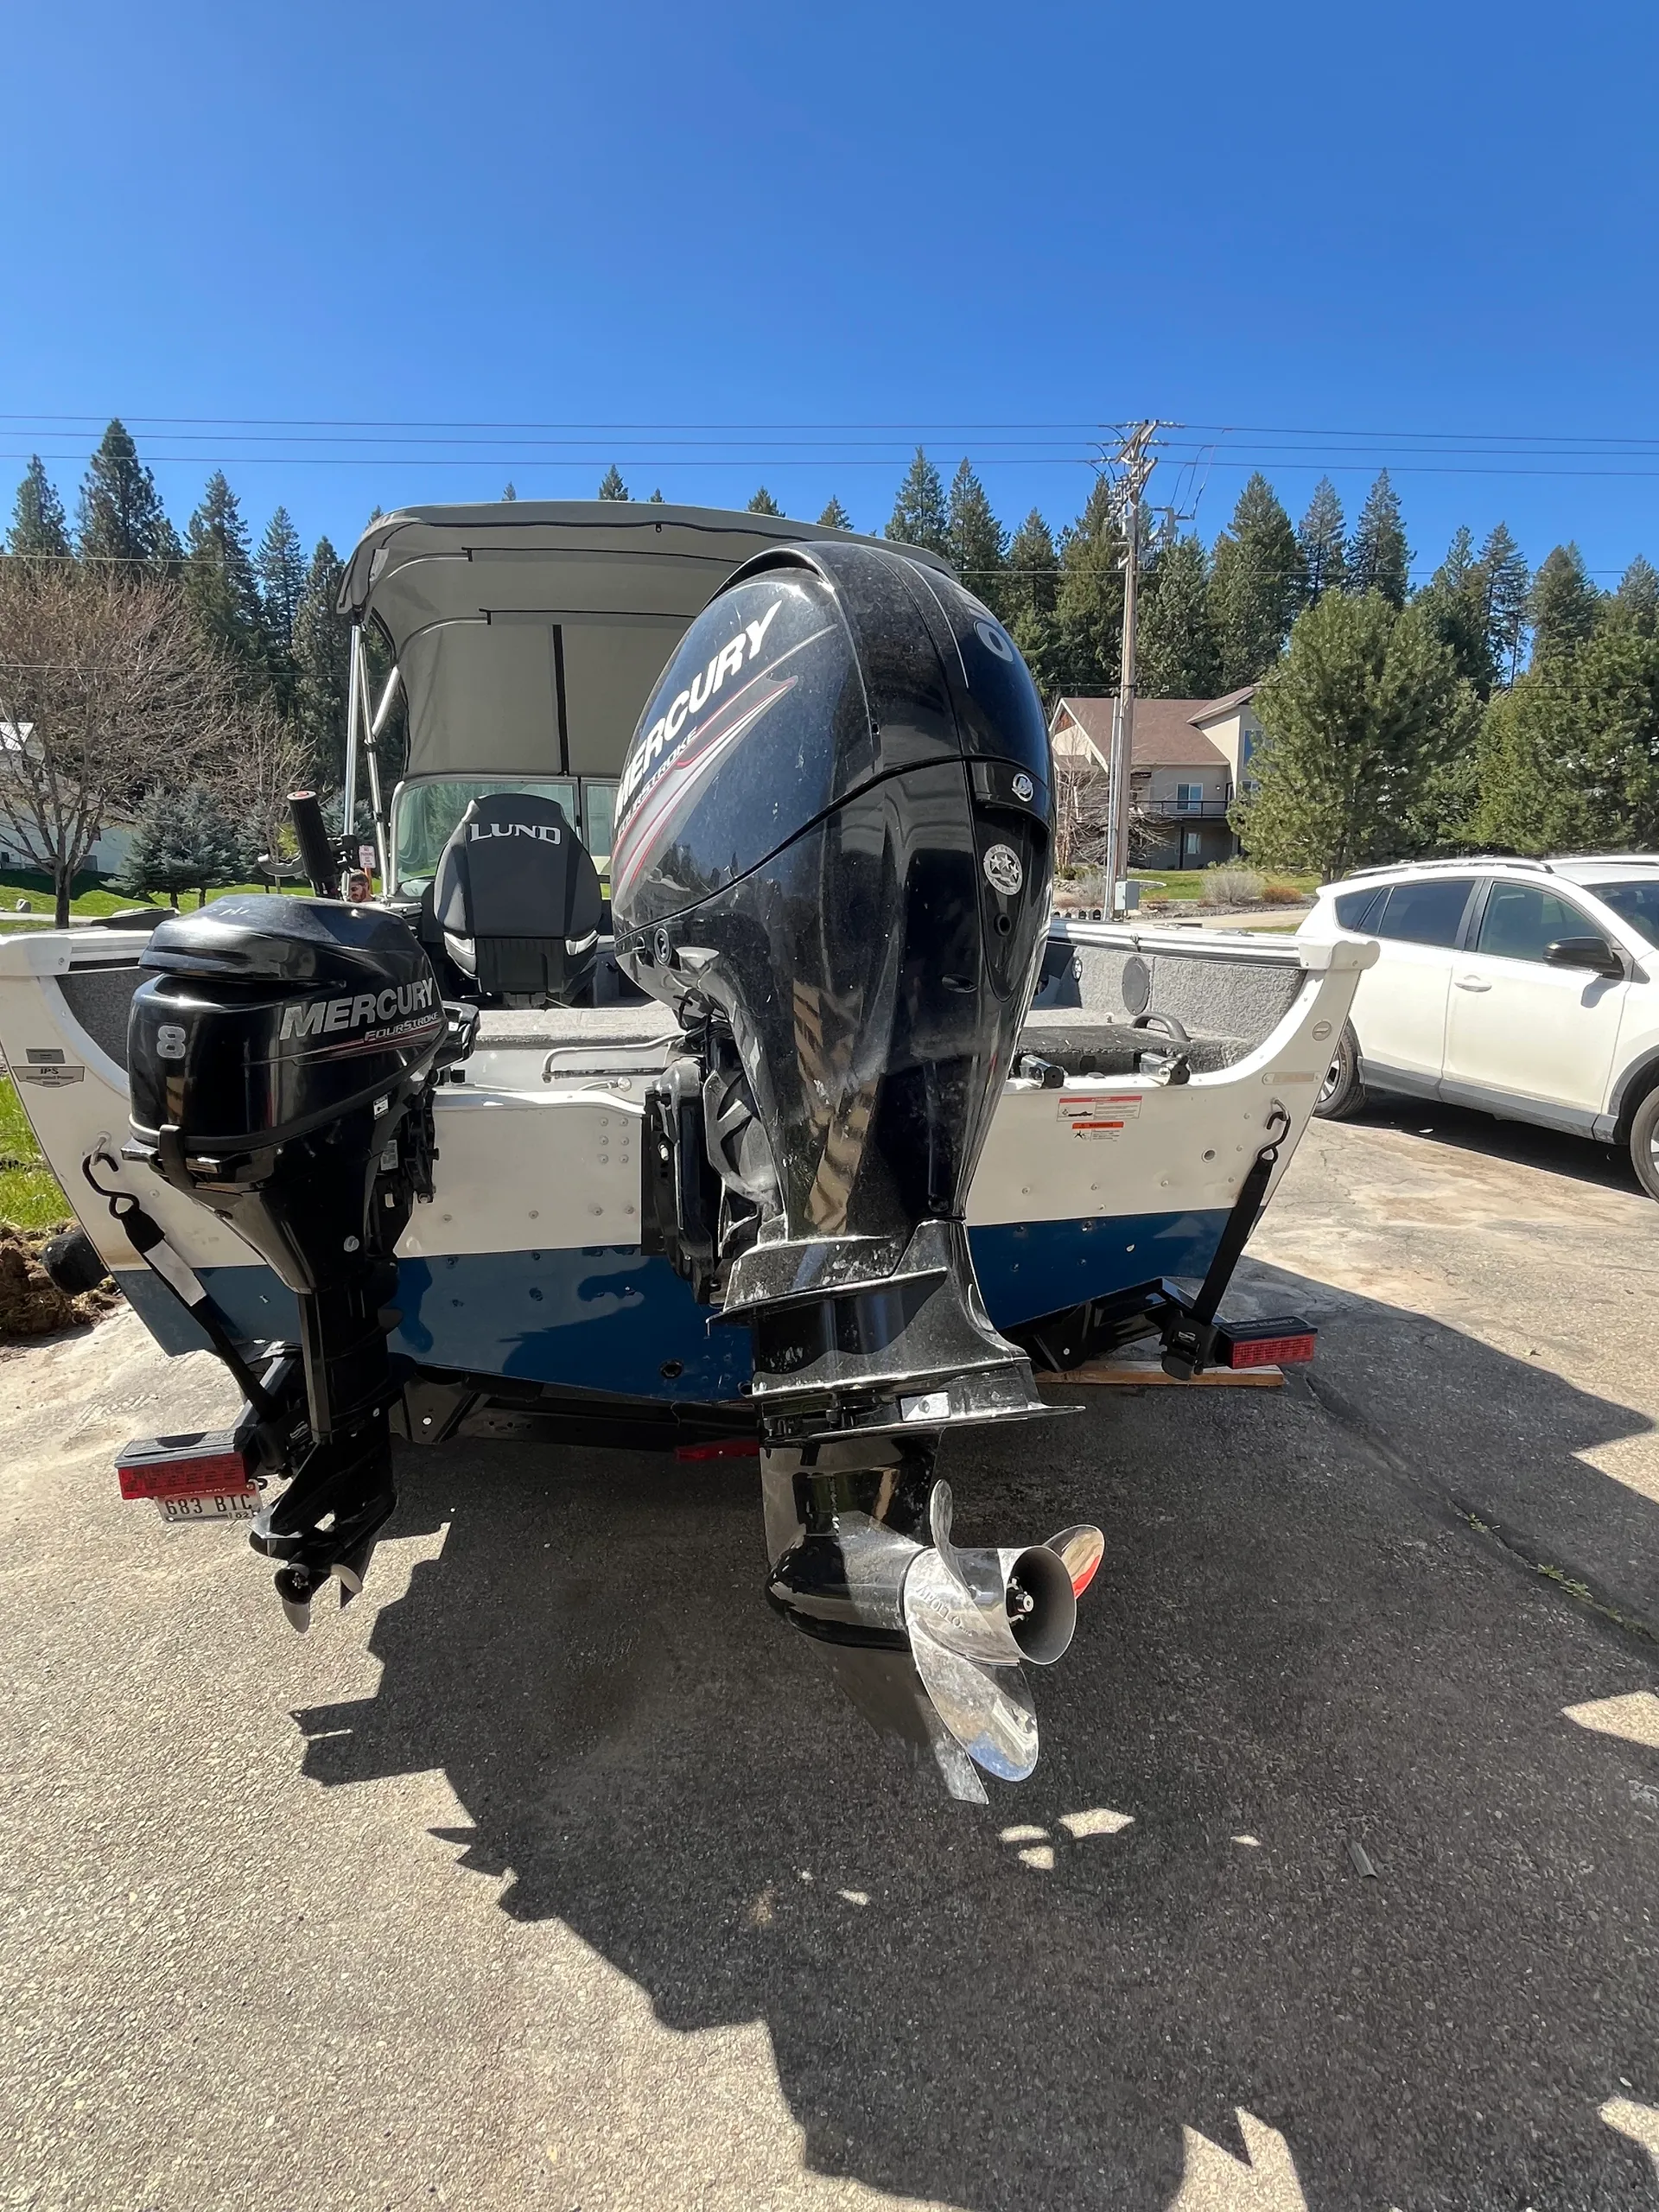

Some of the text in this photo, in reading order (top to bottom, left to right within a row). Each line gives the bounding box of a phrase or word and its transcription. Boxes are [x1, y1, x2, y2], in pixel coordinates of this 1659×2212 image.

[614, 600, 782, 828] MERCURY
[469, 823, 561, 845] LUND
[279, 977, 433, 1040] MERCURY
[156, 1026, 186, 1058] 8
[165, 1497, 203, 1515] 683
[214, 1493, 252, 1512] BTC
